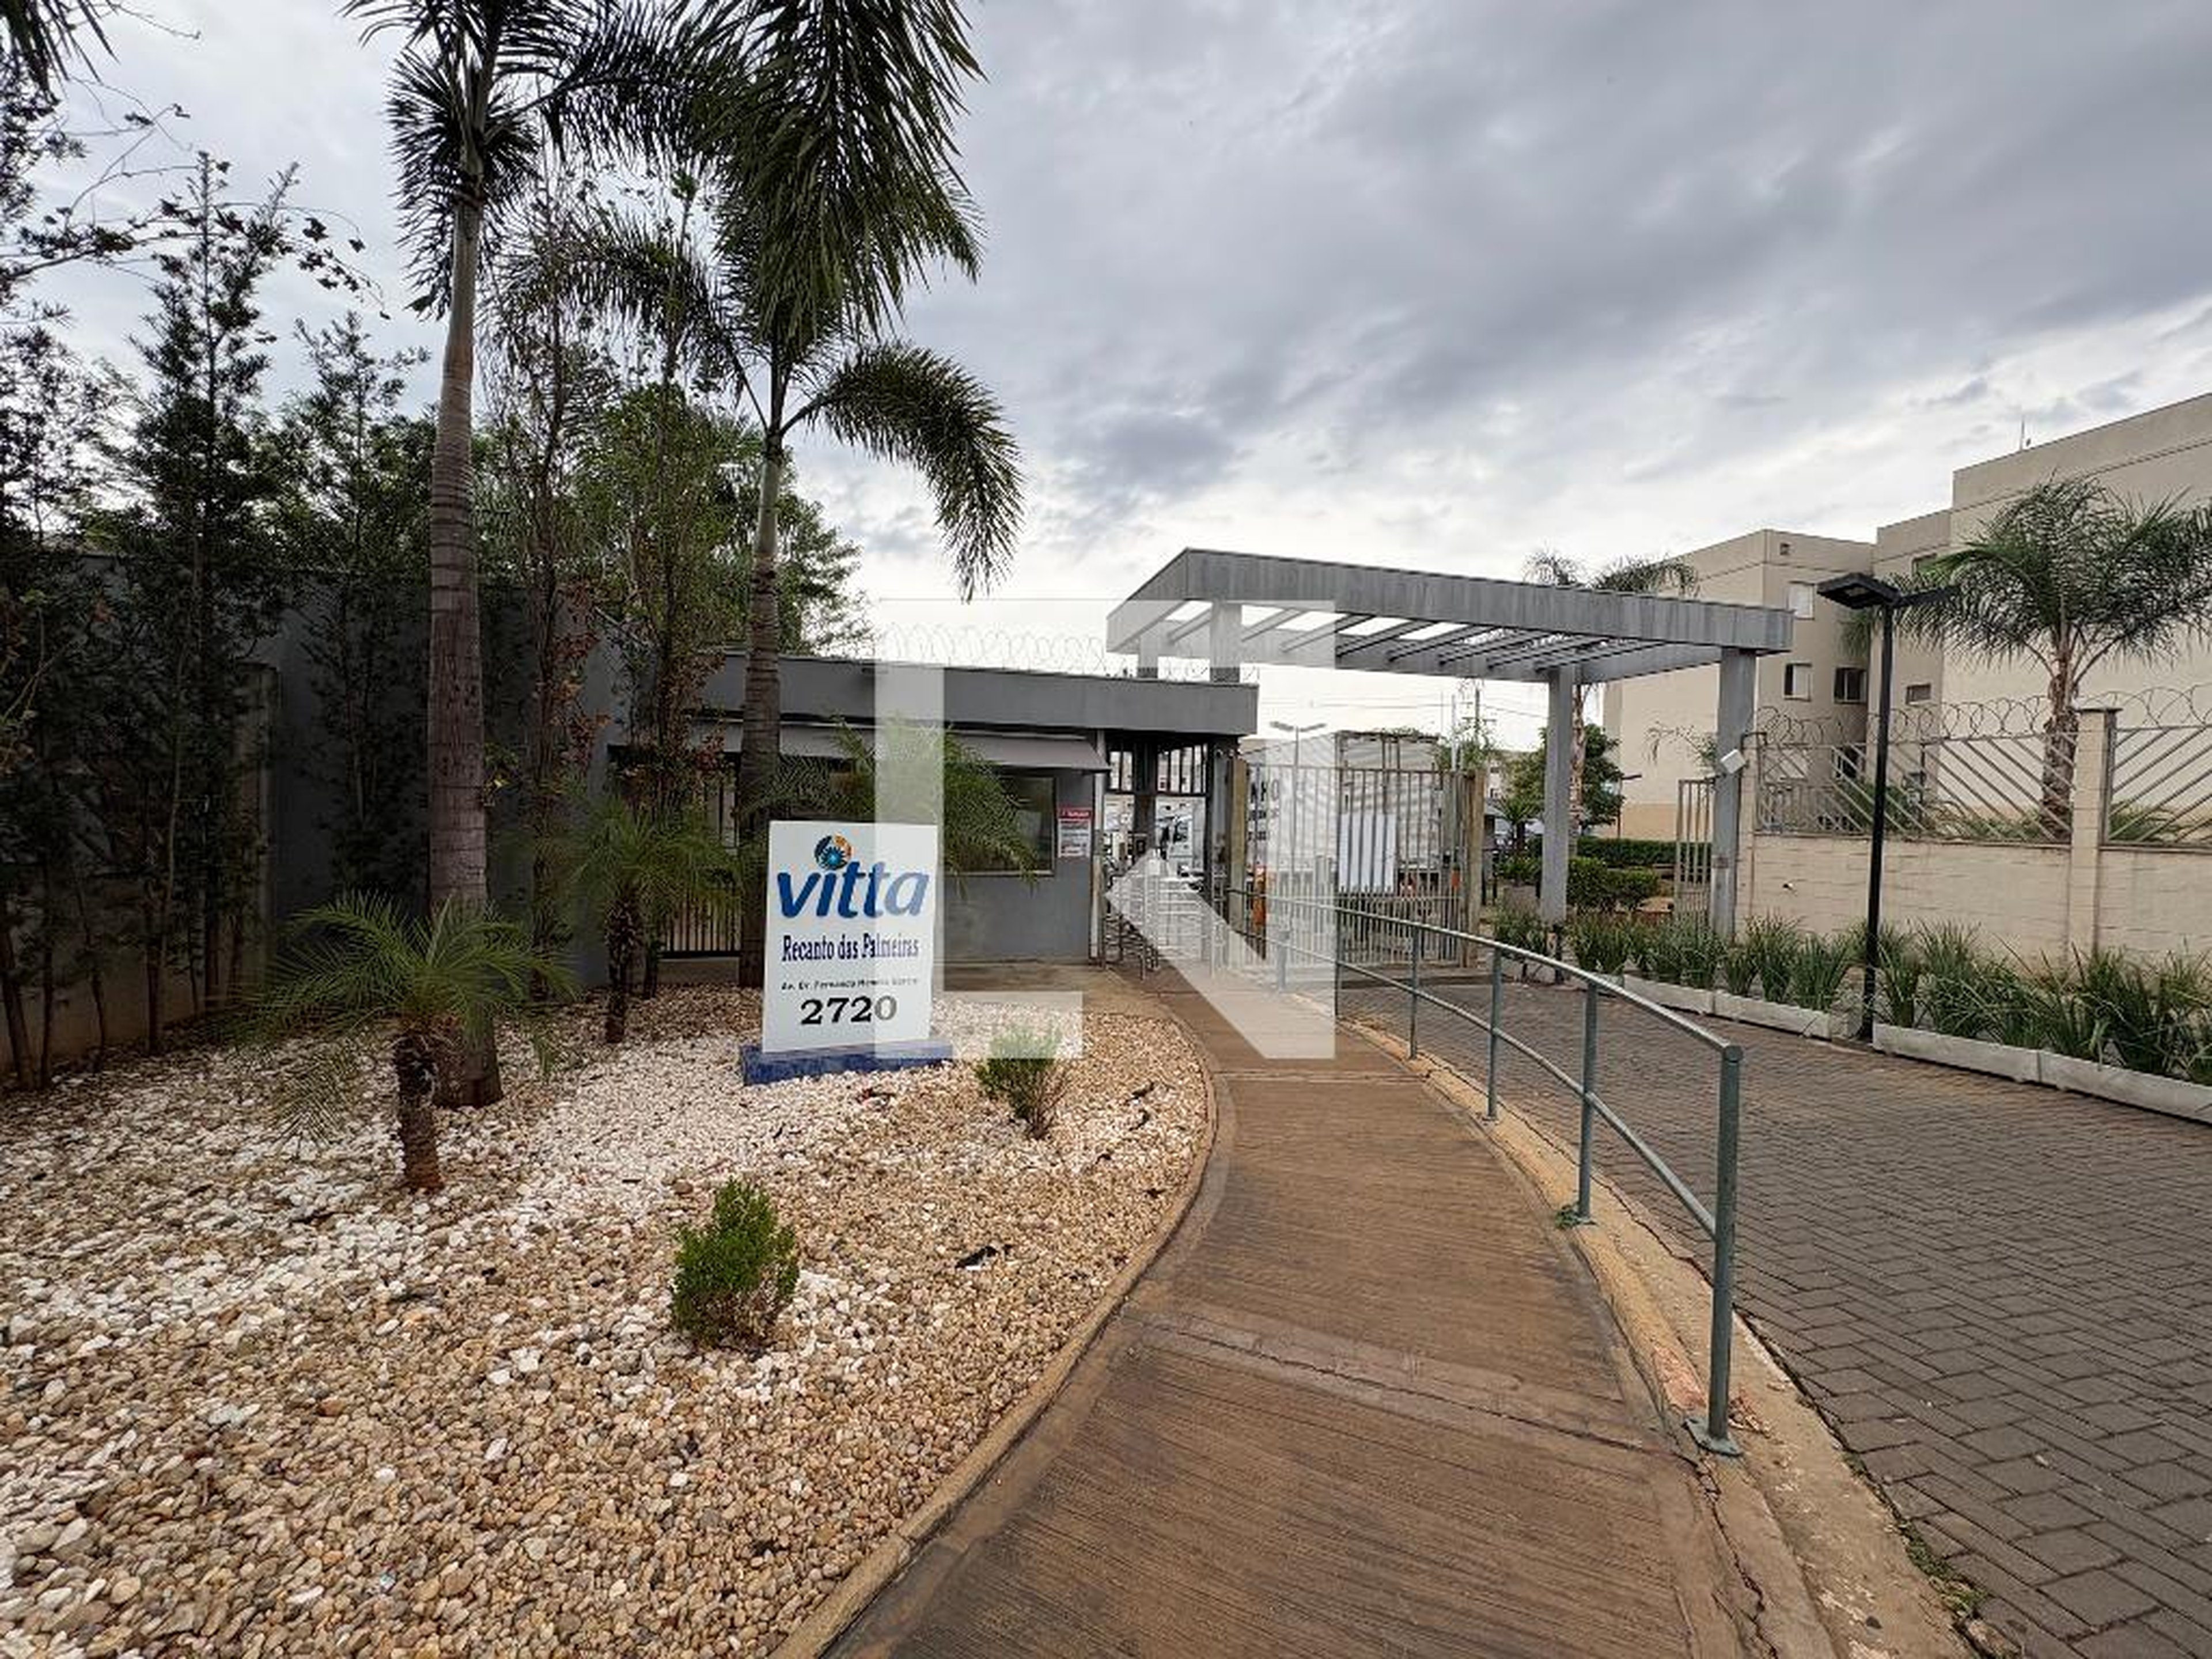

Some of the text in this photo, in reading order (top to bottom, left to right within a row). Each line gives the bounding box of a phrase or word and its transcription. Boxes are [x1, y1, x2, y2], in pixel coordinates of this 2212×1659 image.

[776, 861, 930, 919] vitta
[781, 932, 919, 961] Recanto das Palmeiras
[800, 995, 897, 1025] 2720
